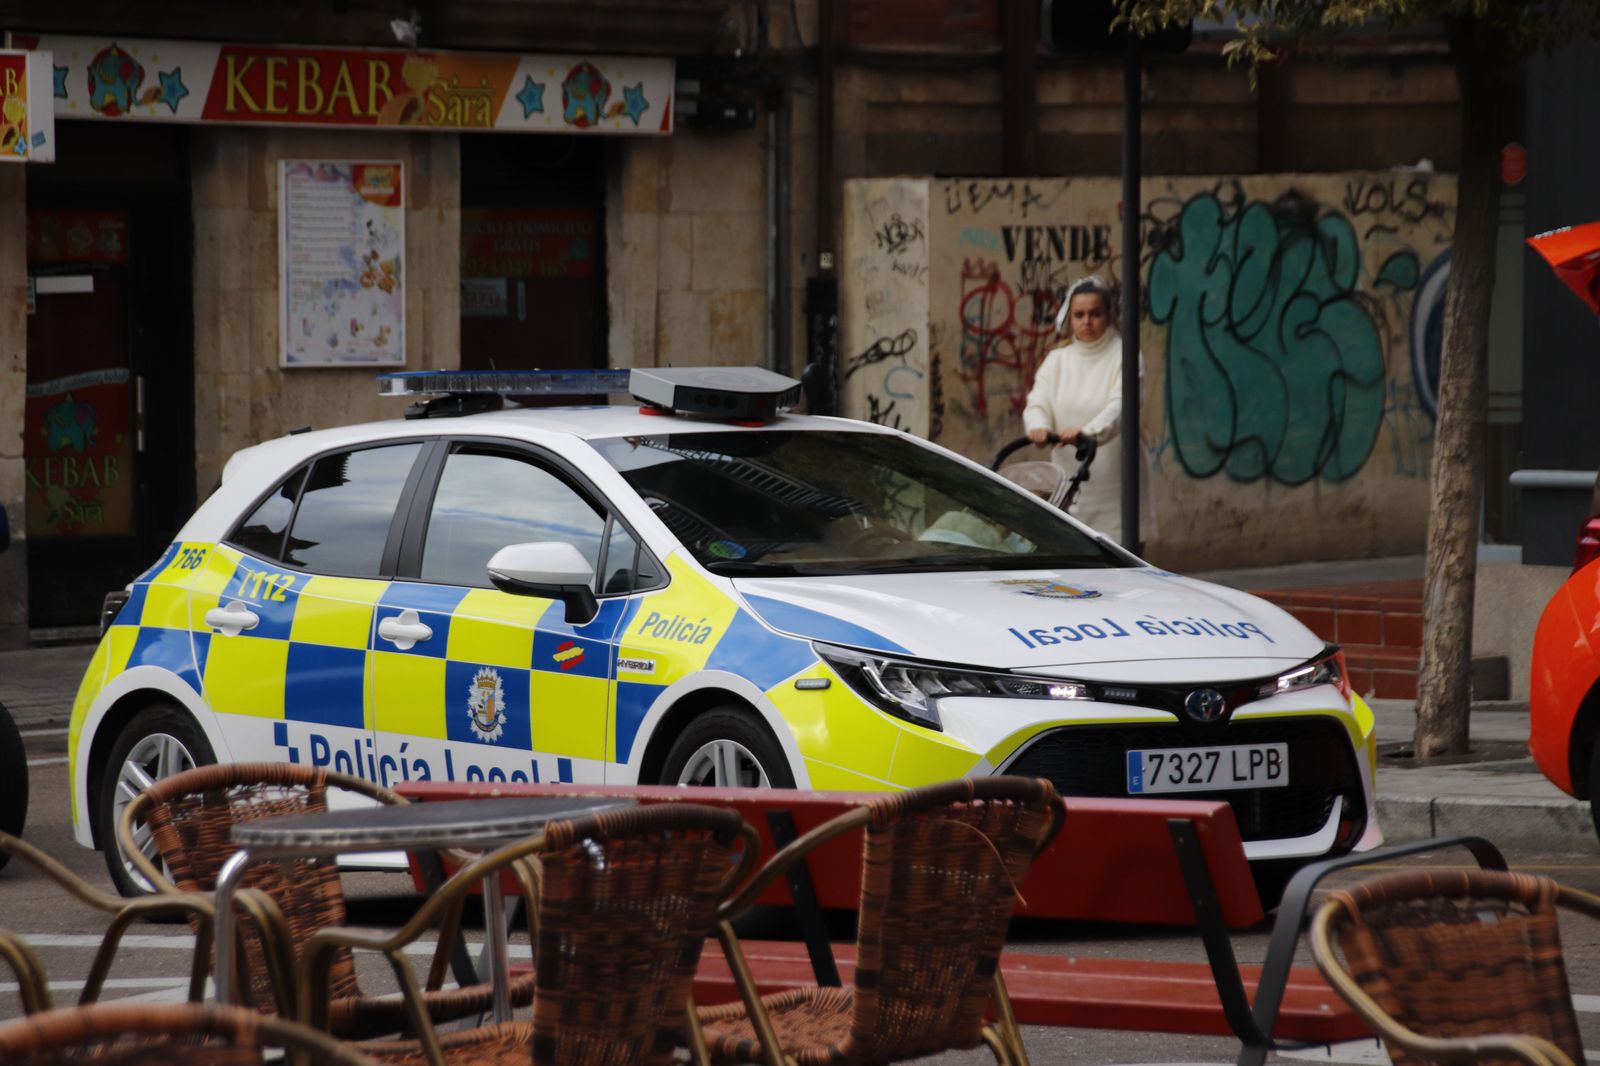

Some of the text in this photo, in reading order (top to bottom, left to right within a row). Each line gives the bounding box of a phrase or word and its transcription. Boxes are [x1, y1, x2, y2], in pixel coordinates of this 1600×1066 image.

[223, 54, 395, 117] KEBAB
[1001, 224, 1112, 262] VENDE
[26, 455, 120, 488] KEBAB
[173, 548, 206, 570] 766
[638, 611, 713, 645] Policía
[1148, 750, 1221, 787] 7327
[1231, 747, 1282, 782] LPB
